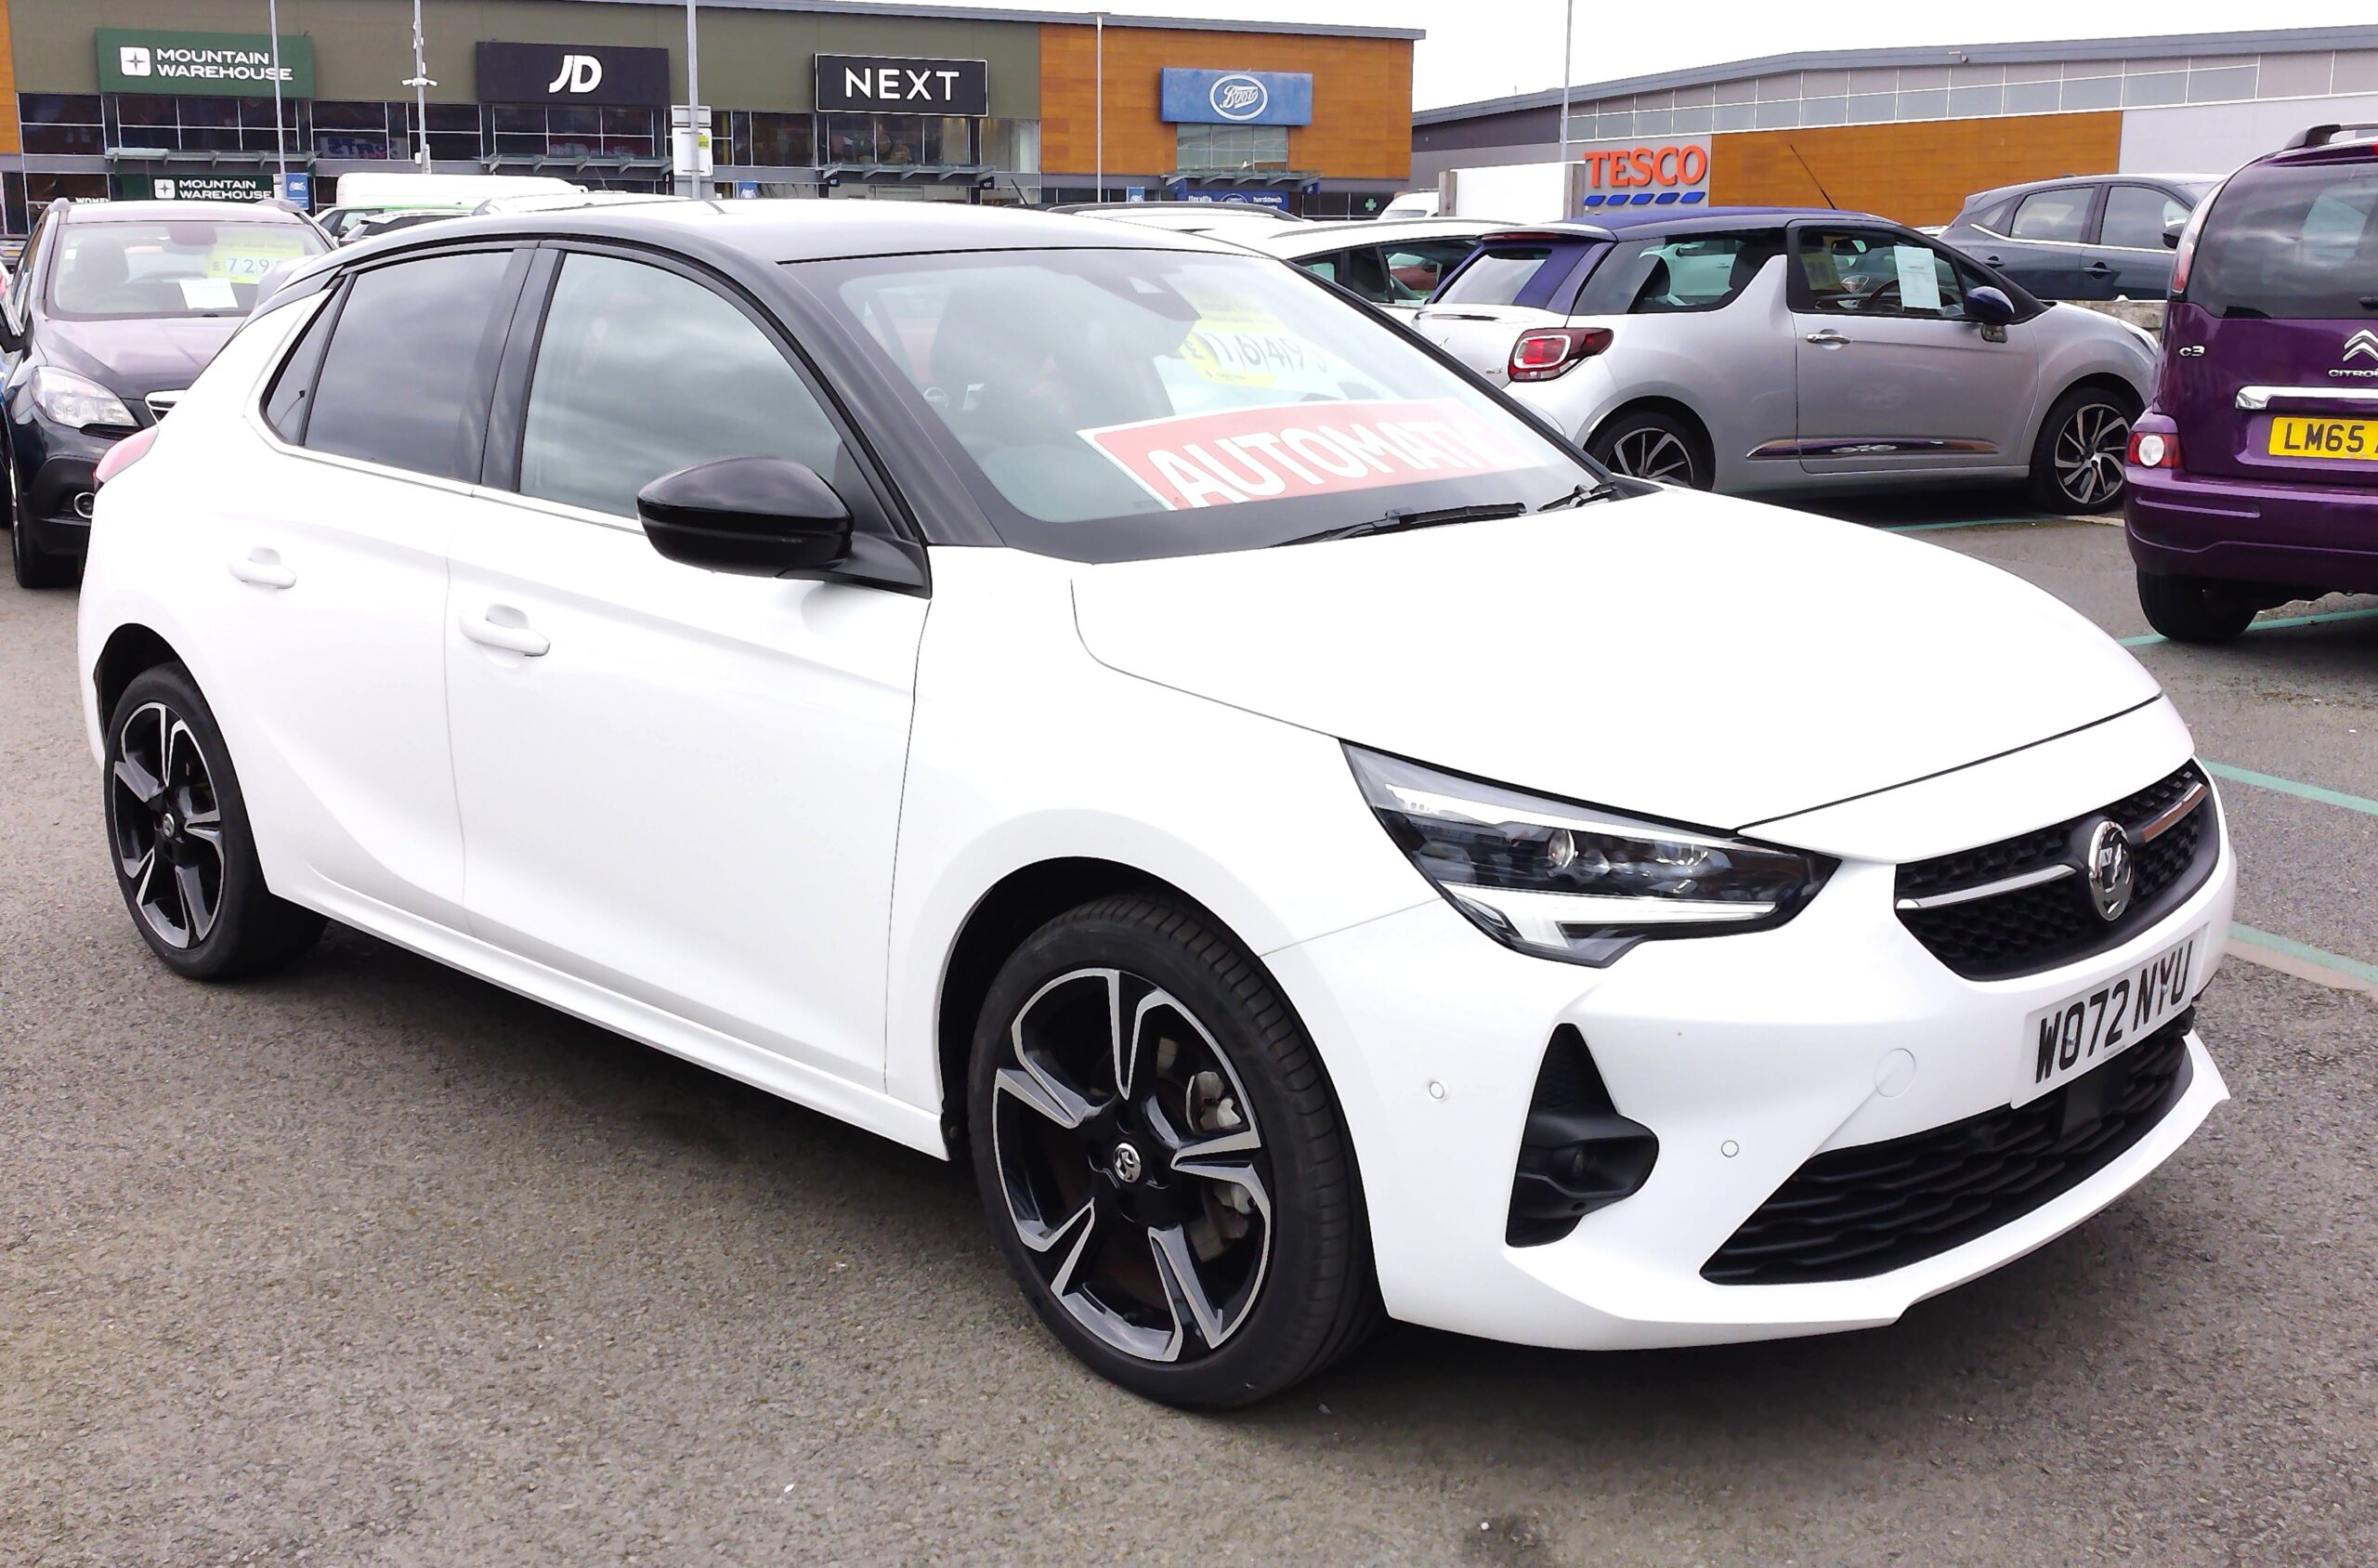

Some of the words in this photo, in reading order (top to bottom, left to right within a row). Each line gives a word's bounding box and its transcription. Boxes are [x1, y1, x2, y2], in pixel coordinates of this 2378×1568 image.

[156, 48, 269, 65] MOUNTAIN
[156, 64, 294, 81] WAREHOUSE
[548, 54, 603, 94] JD
[845, 66, 960, 101] NEXT
[1219, 85, 1259, 110] Boots
[1583, 145, 1708, 188] TESCO
[178, 178, 256, 189] MOUNTAIN
[178, 189, 272, 201] WAREHOUSE
[2283, 423, 2365, 453] LM65
[2133, 939, 2194, 1033] NYU
